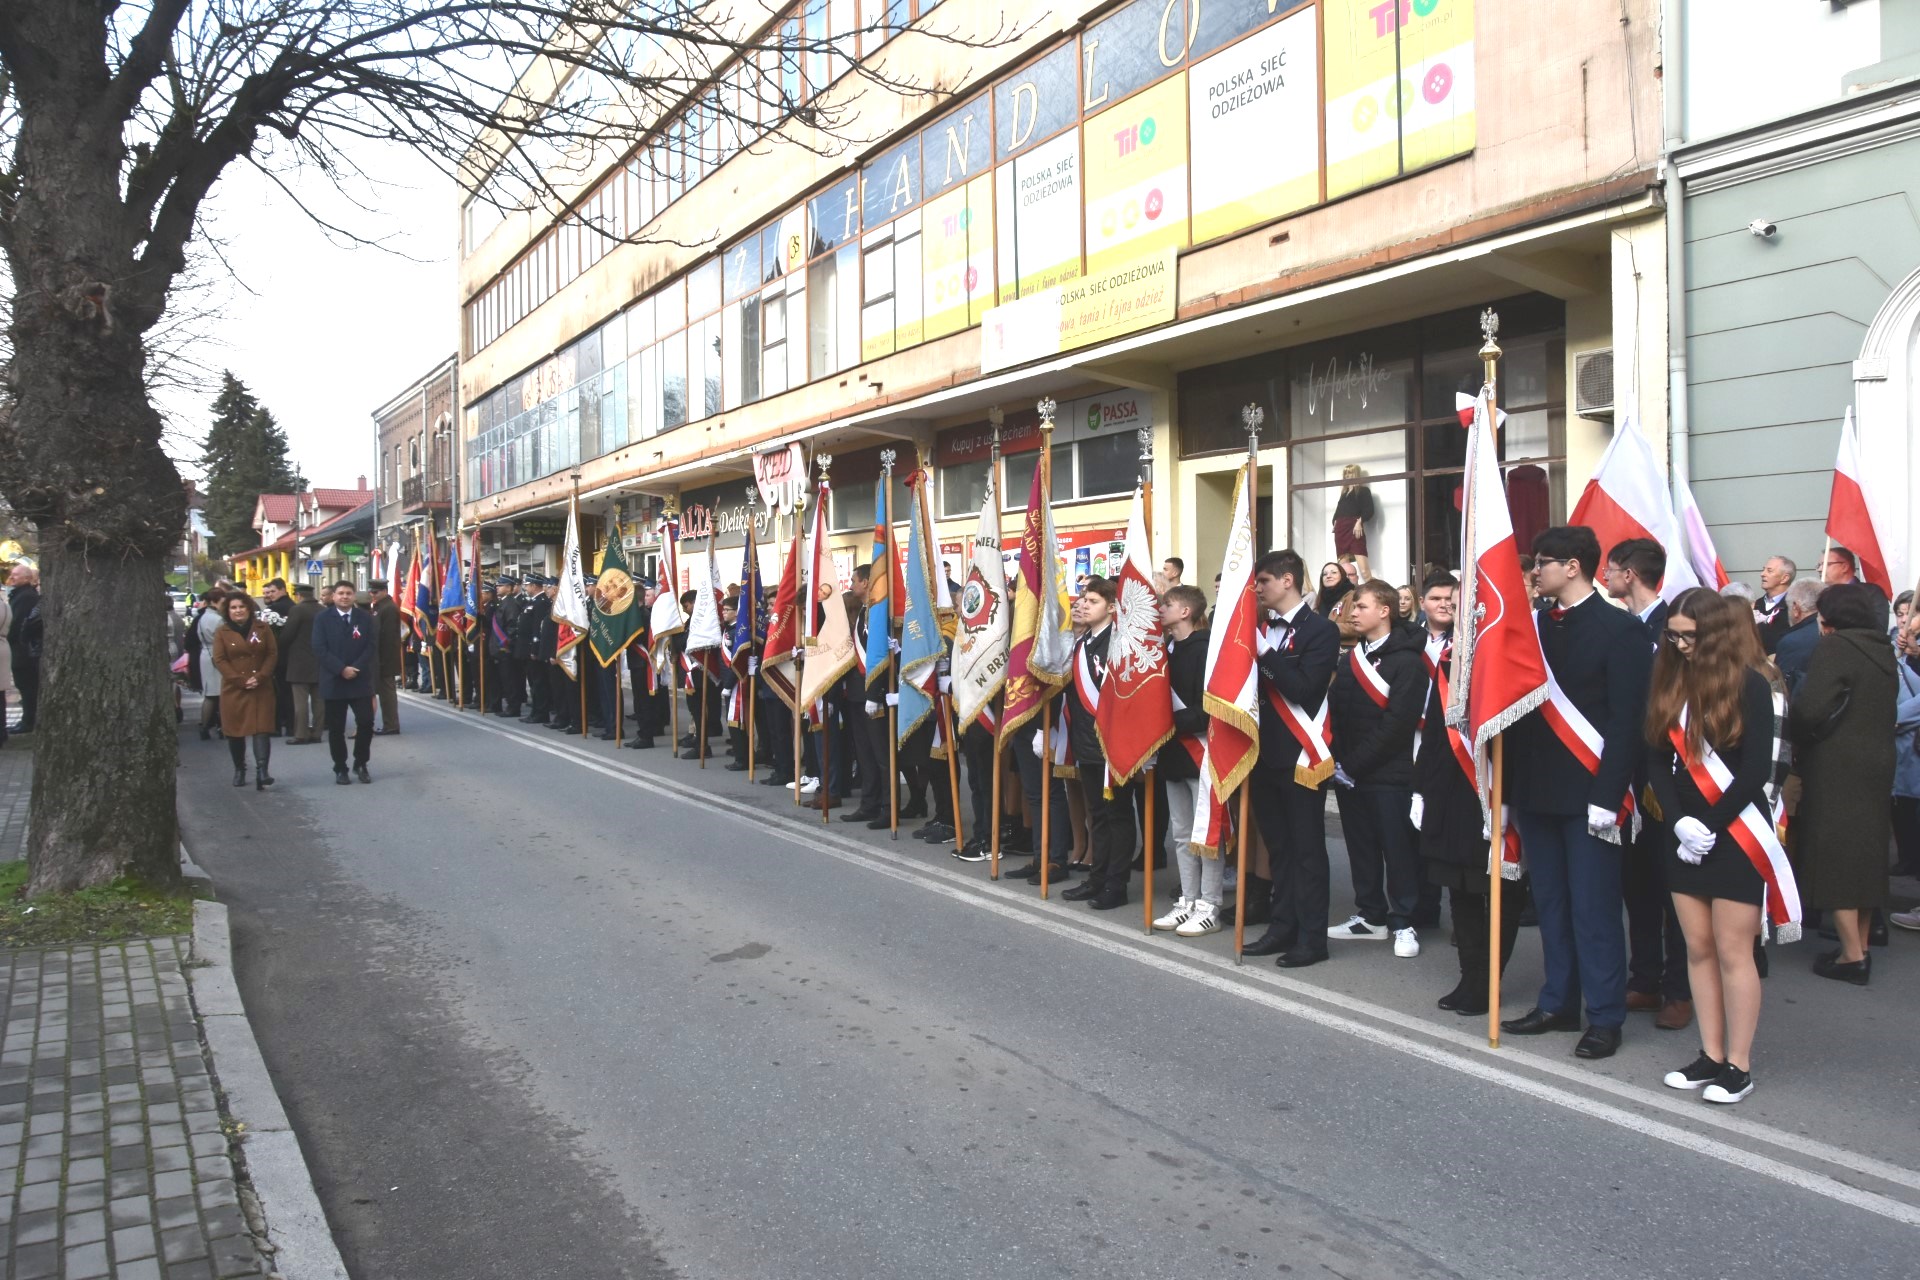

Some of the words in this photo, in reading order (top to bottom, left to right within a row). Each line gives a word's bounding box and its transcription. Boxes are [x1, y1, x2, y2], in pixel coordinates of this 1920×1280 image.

[1209, 69, 1254, 101] POLSKA
[1260, 47, 1288, 76] SIEĆ
[1211, 75, 1285, 119] ODZIEŻOWA
[1021, 167, 1052, 191] POLSKA
[1056, 153, 1075, 176] SIEĆ
[1023, 175, 1074, 207] ODZIEŻOWA
[1090, 279, 1107, 296] SIEĆ
[1110, 260, 1165, 290] ODZIEŻOWA
[1109, 298, 1132, 321] fajna
[1135, 285, 1164, 309] odzież
[1103, 400, 1138, 421] PASSA
[951, 435, 974, 454] Kupuj
[976, 437, 982, 448] z
[759, 448, 793, 485] RED
[766, 480, 808, 519] PUB
[679, 504, 713, 540] ALTA
[720, 505, 769, 537] Delikaesy
[975, 673, 987, 688] W
